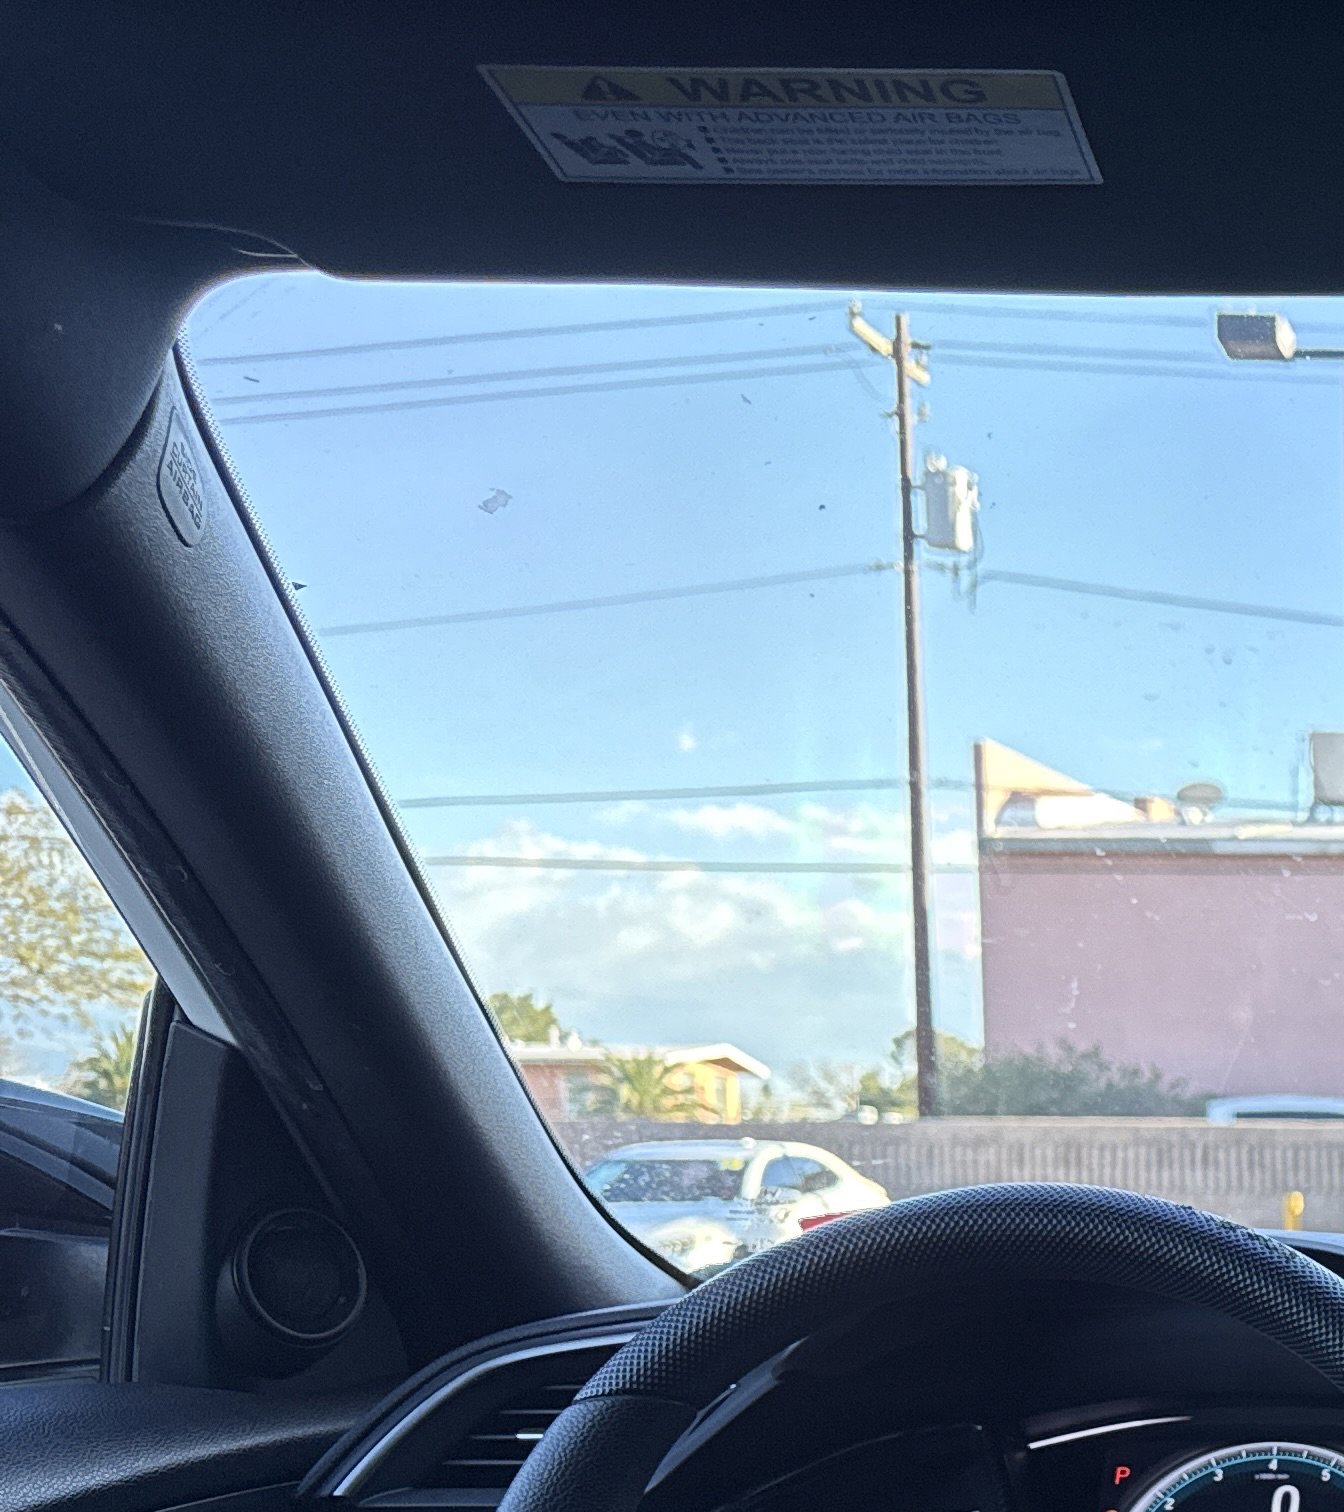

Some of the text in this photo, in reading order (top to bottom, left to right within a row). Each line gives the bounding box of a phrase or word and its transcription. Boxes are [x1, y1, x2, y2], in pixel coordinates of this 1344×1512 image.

[666, 76, 987, 104] WARNING
[655, 109, 729, 123] WITH
[737, 110, 886, 124] ADVANCED
[893, 111, 938, 124] AIR
[945, 111, 1022, 126] BAGS
[1113, 1464, 1132, 1486] P
[1212, 1468, 1224, 1482] 3
[1320, 1468, 1331, 1482] 5
[1163, 1497, 1176, 1511] 2
